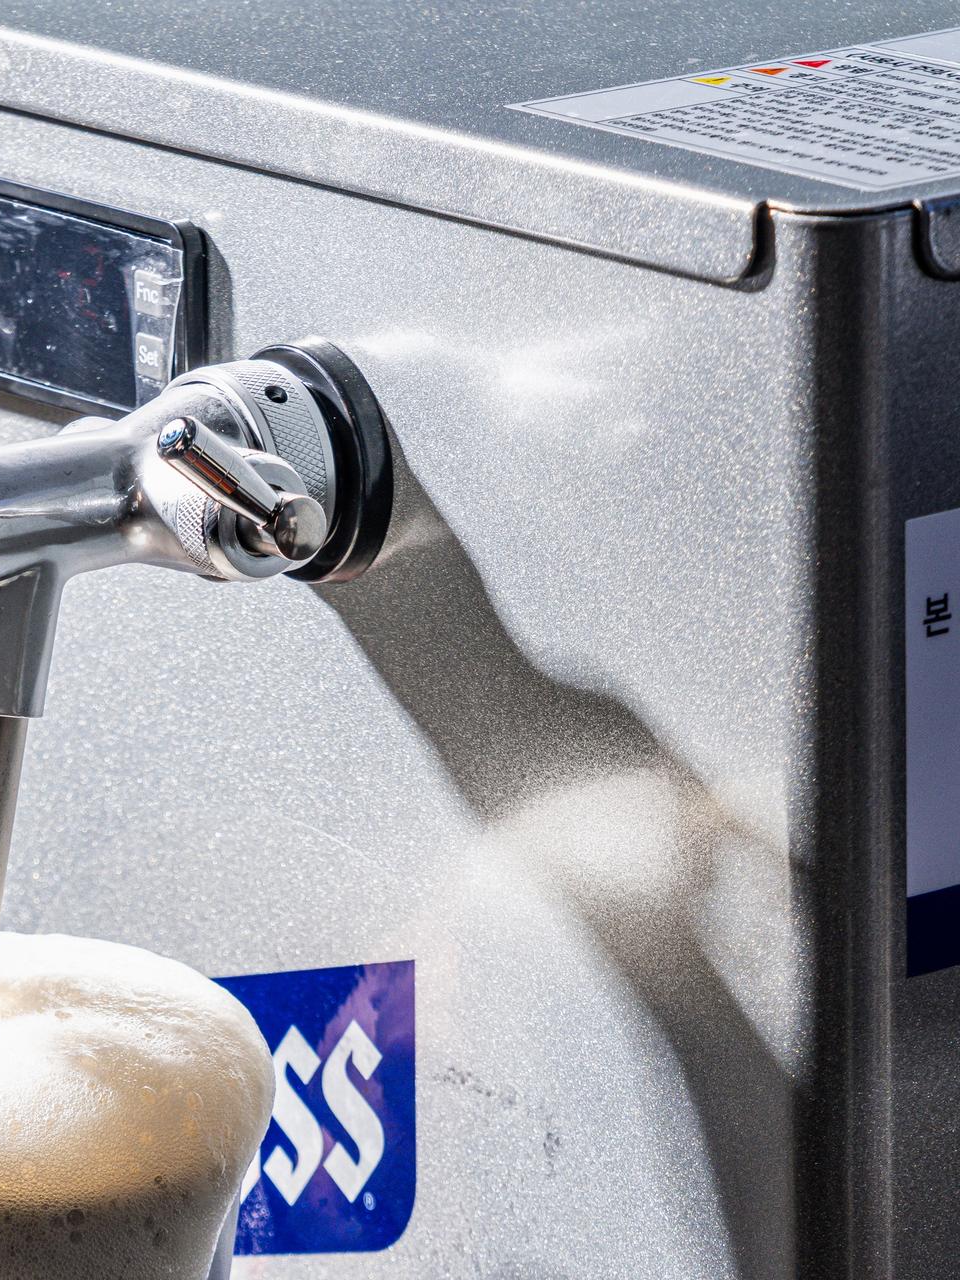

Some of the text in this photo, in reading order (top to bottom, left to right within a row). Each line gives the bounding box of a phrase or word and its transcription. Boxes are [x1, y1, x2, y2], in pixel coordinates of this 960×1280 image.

[729, 82, 771, 93] 주의
[136, 281, 159, 304] Fnc
[138, 345, 159, 367] Set
[241, 1018, 385, 1206] SS
